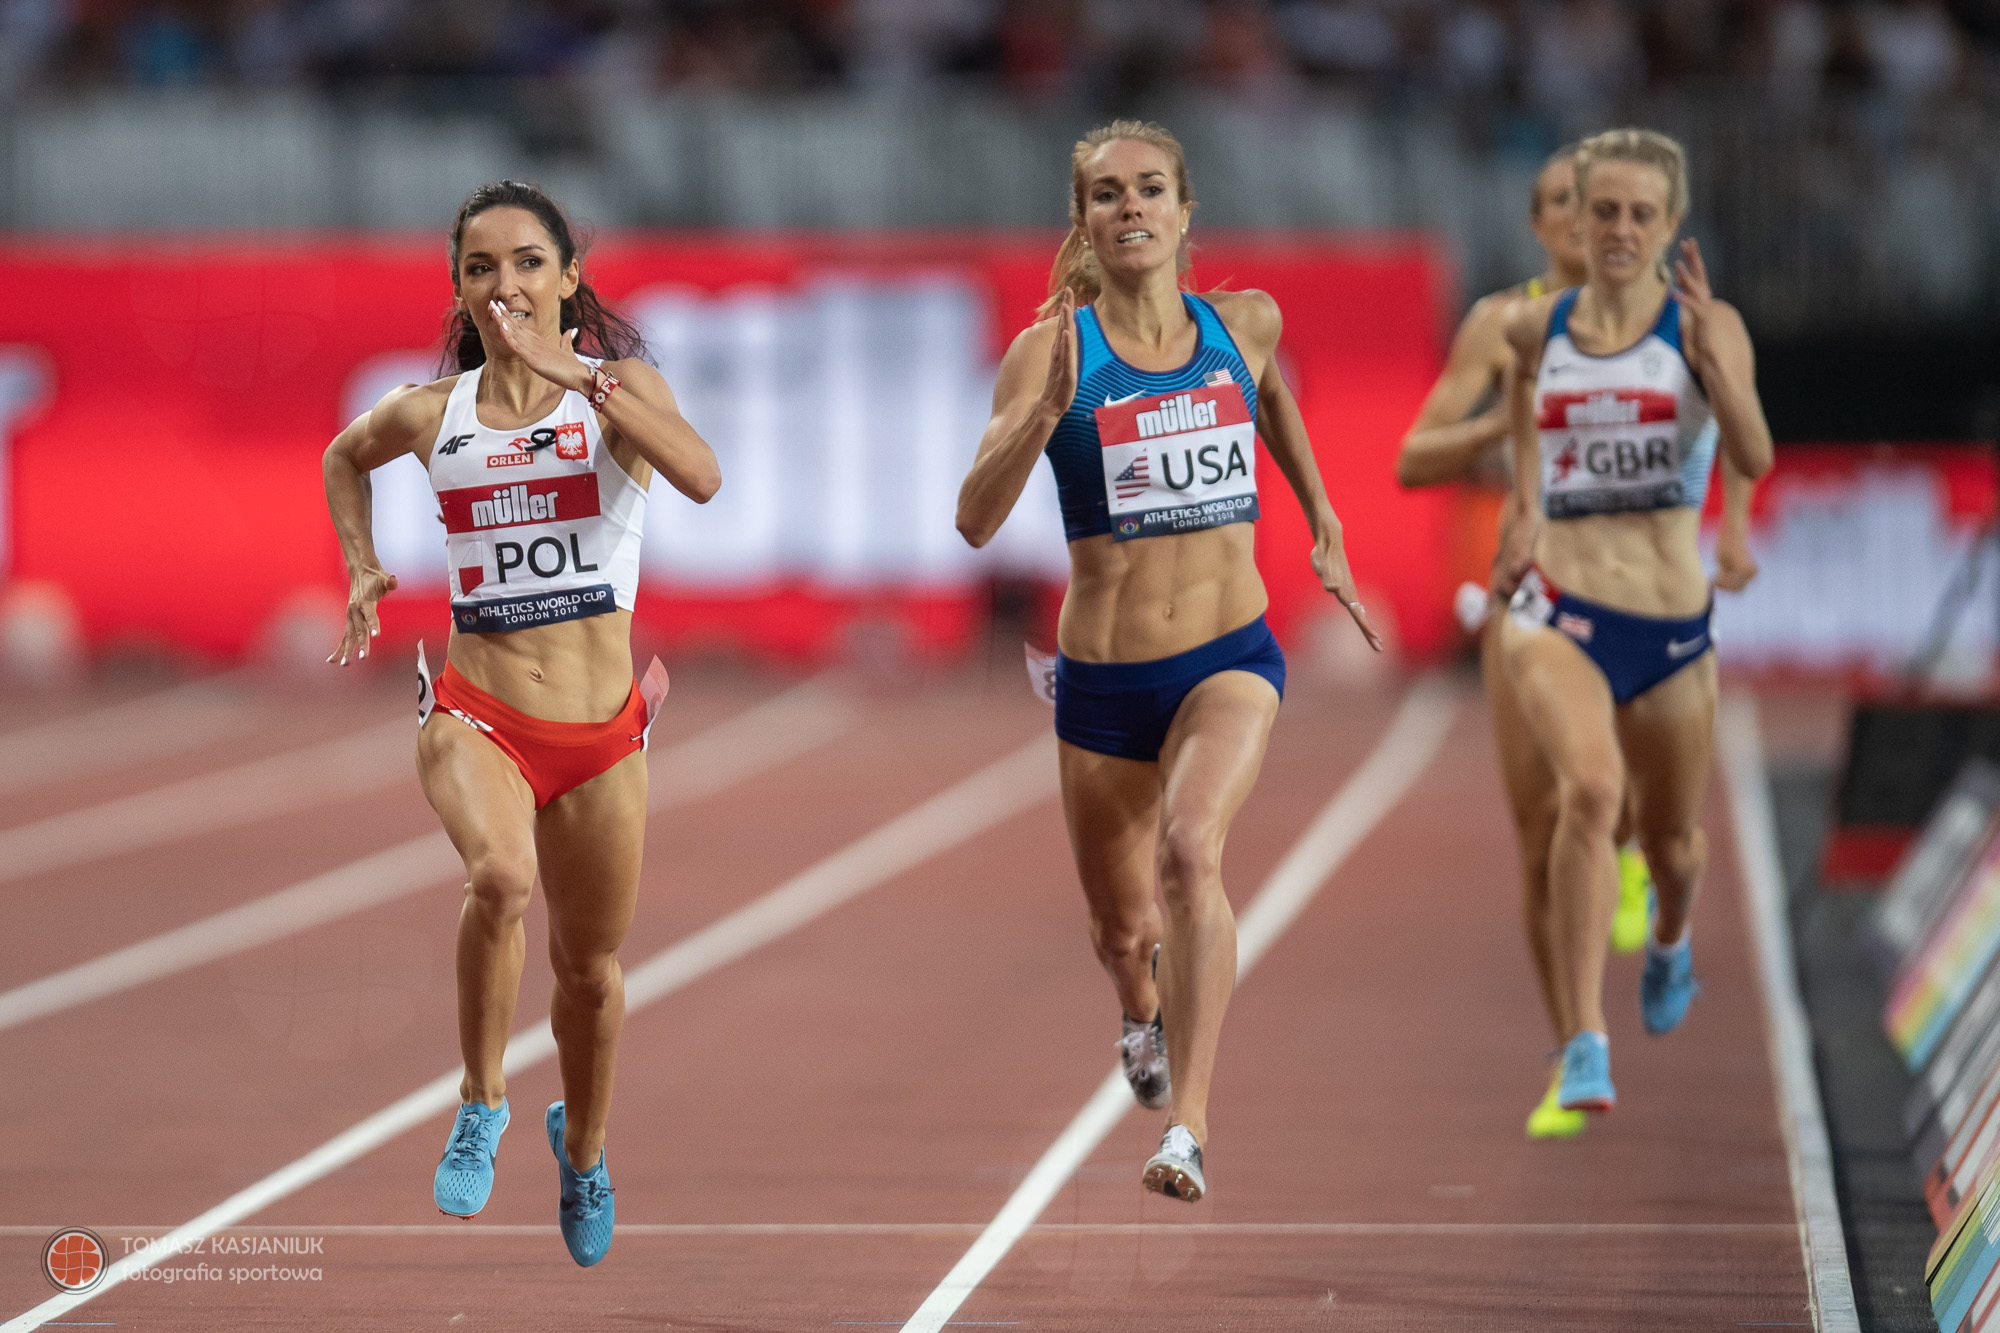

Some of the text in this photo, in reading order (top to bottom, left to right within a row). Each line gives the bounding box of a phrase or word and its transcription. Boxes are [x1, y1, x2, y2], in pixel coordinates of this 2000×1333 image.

[557, 423, 583, 431] POLSKA
[1136, 393, 1218, 439] müller
[489, 454, 532, 466] ORLEN
[1160, 440, 1248, 491] USA
[1585, 437, 1671, 479] GBR
[471, 484, 559, 528] müller
[1143, 496, 1253, 524] ATHLETICS WORLD CUP
[1173, 511, 1235, 528] LONDON 2018
[495, 533, 599, 583] POL
[479, 590, 607, 617] ATHLETICS WORLD CUP
[505, 605, 578, 624] LONDON 2018
